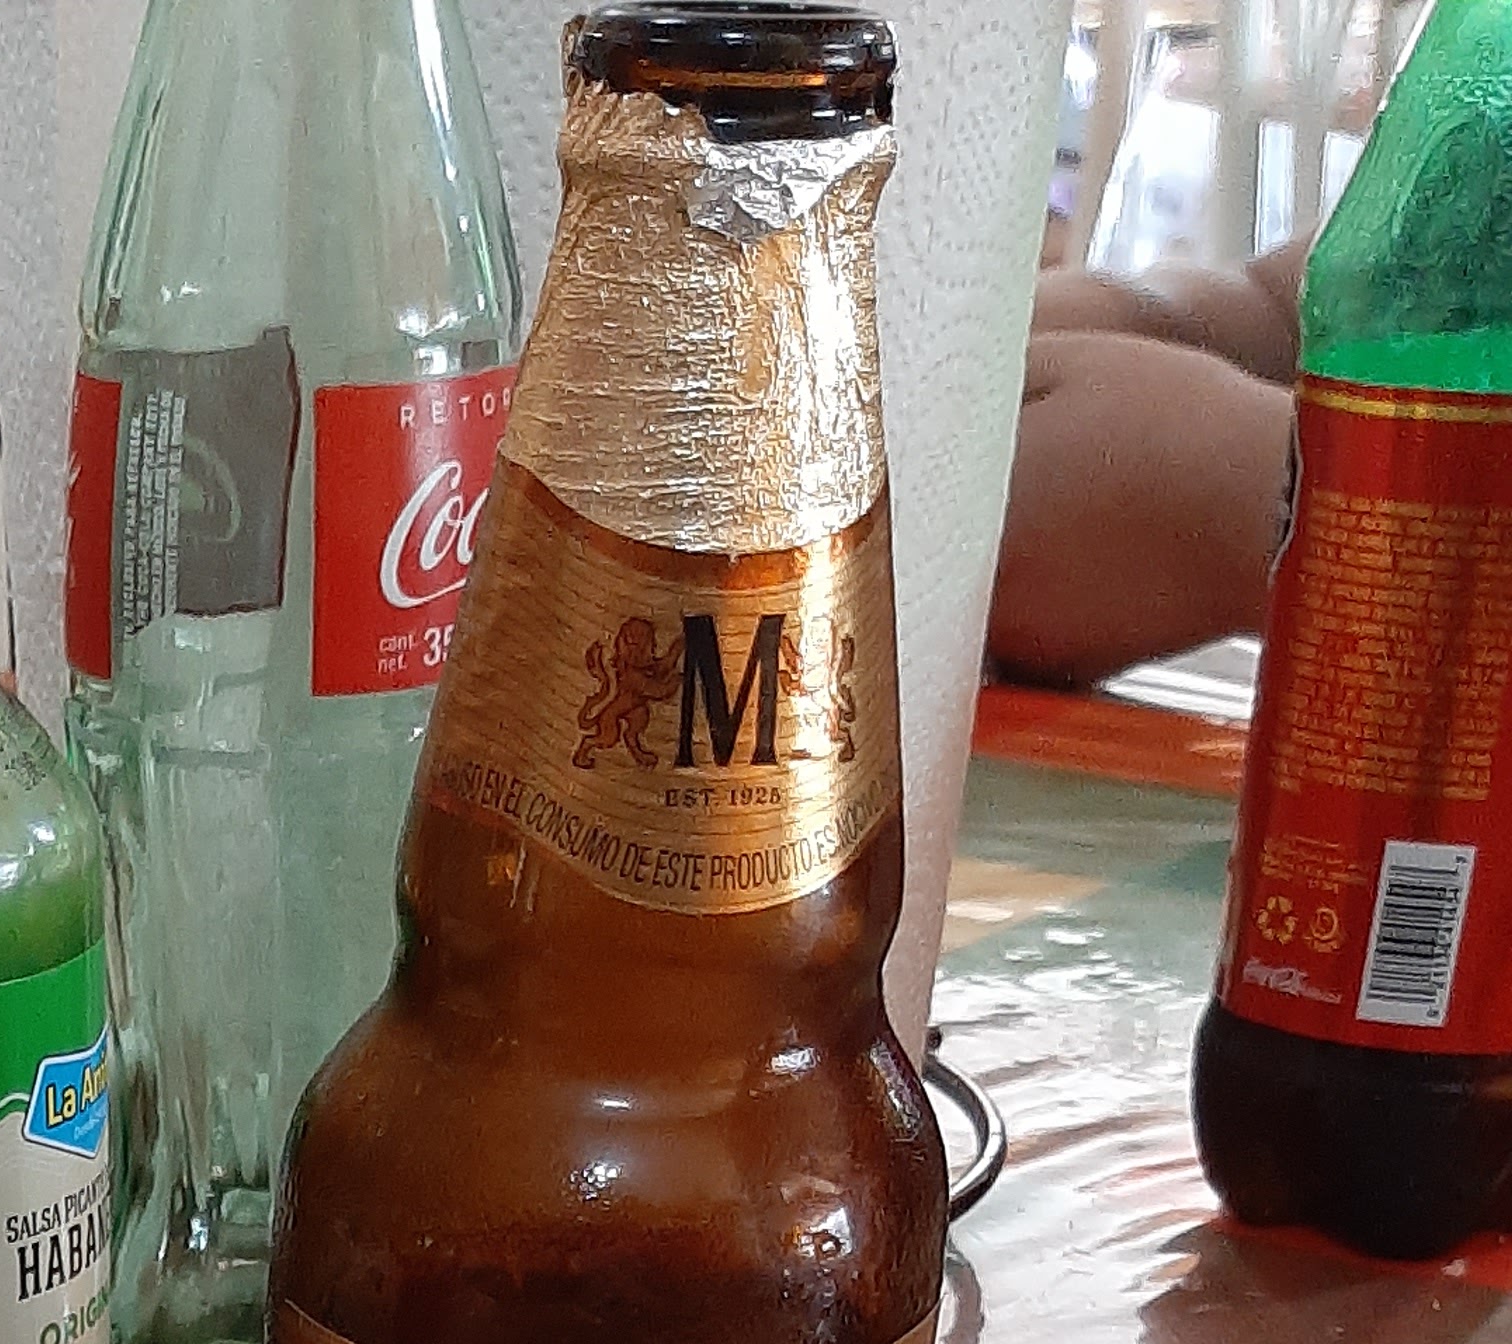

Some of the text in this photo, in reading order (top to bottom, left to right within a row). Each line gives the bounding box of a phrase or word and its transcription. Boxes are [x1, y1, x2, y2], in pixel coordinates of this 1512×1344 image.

[380, 459, 490, 609] Coc
[423, 624, 455, 668] 35
[674, 614, 787, 769] M
[526, 791, 621, 872] CONSUMO
[619, 842, 653, 883] DE
[652, 850, 706, 892] ESTE
[709, 838, 813, 891] PRODUCTO
[45, 1082, 78, 1130] La
[6, 1172, 108, 1244] SALSA PICANT
